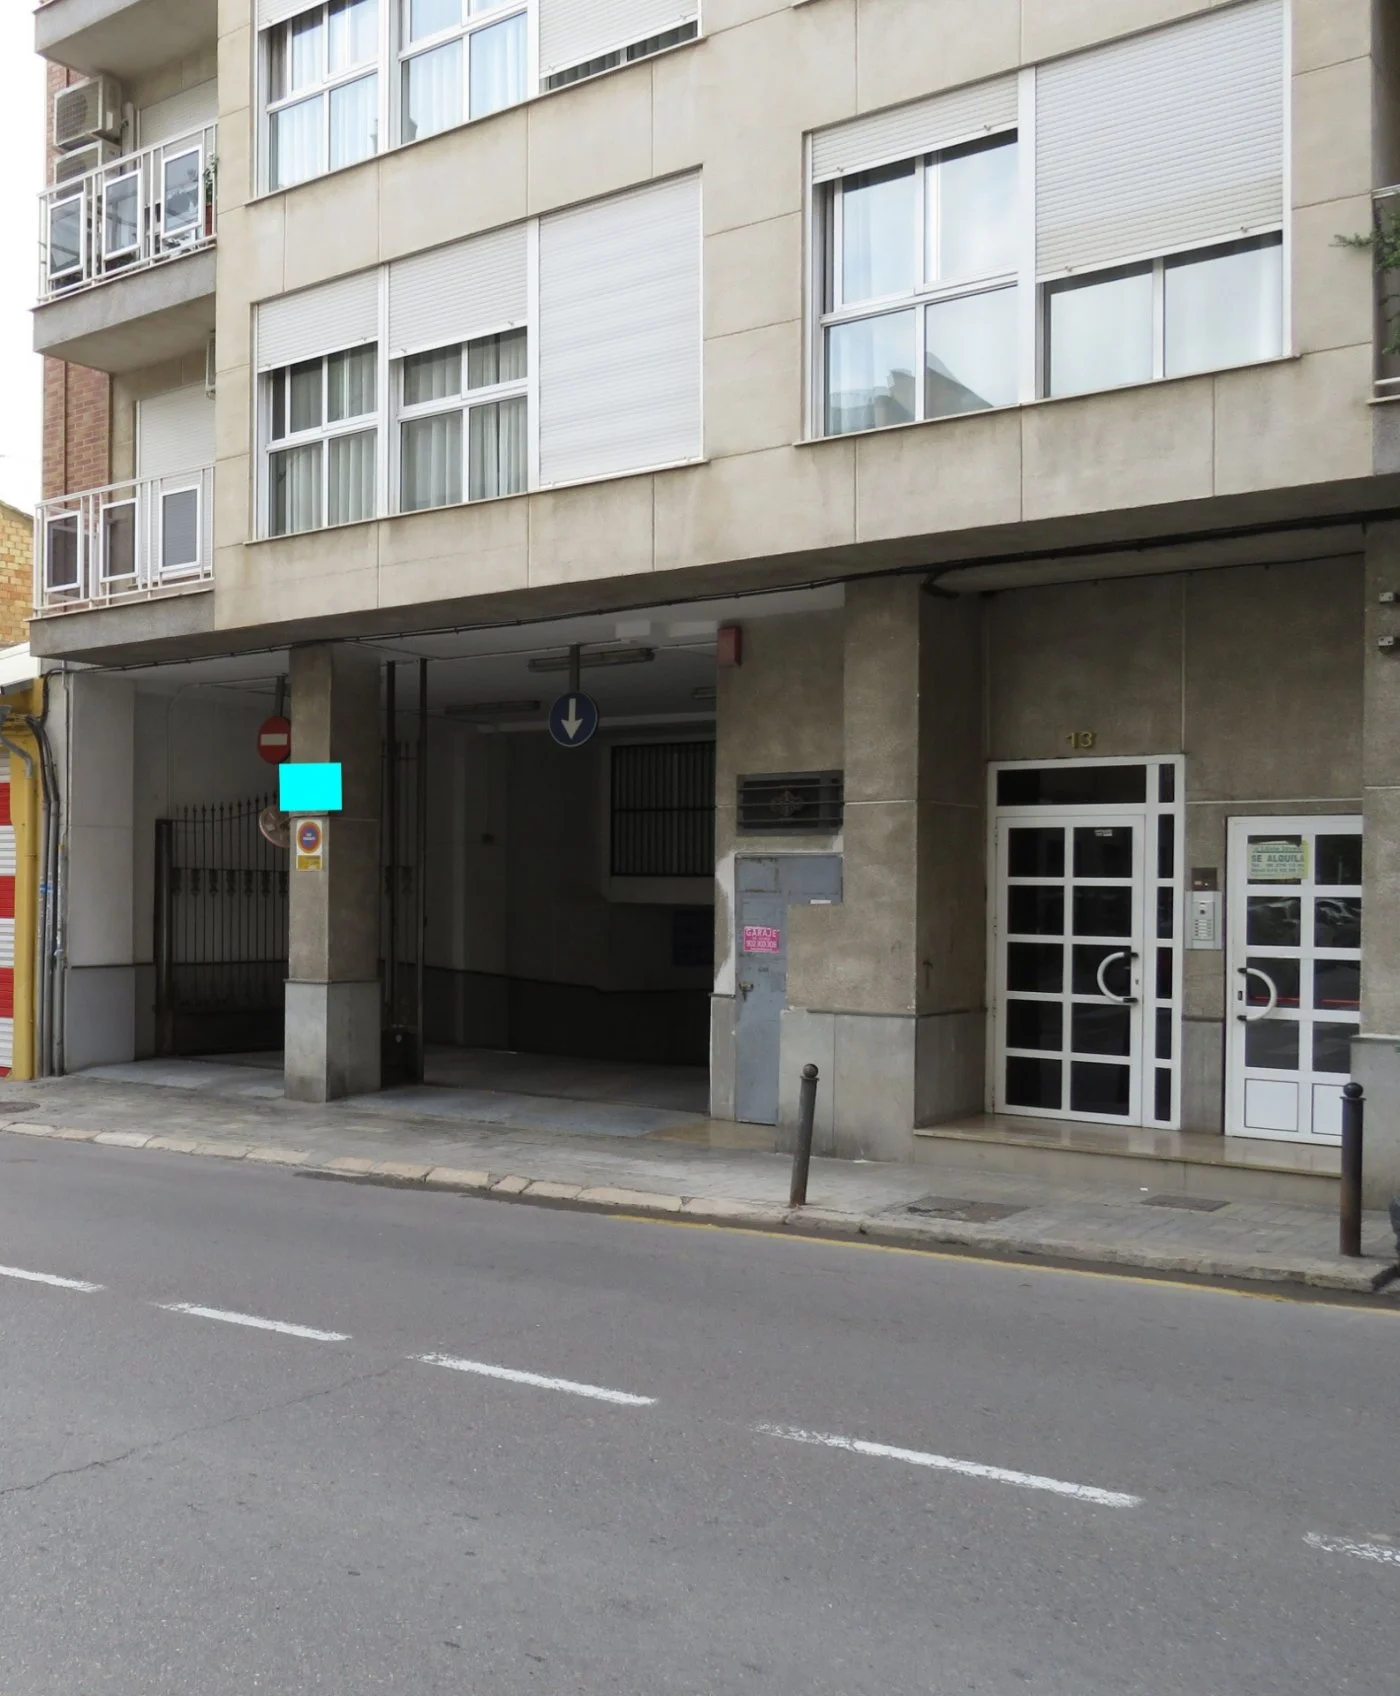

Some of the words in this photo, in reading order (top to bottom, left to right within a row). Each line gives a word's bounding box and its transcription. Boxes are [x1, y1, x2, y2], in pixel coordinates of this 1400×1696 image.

[1065, 731, 1095, 749] 13
[1251, 854, 1262, 862] SE
[1266, 854, 1304, 862] ALQUILA
[745, 928, 776, 938] GARAJE
